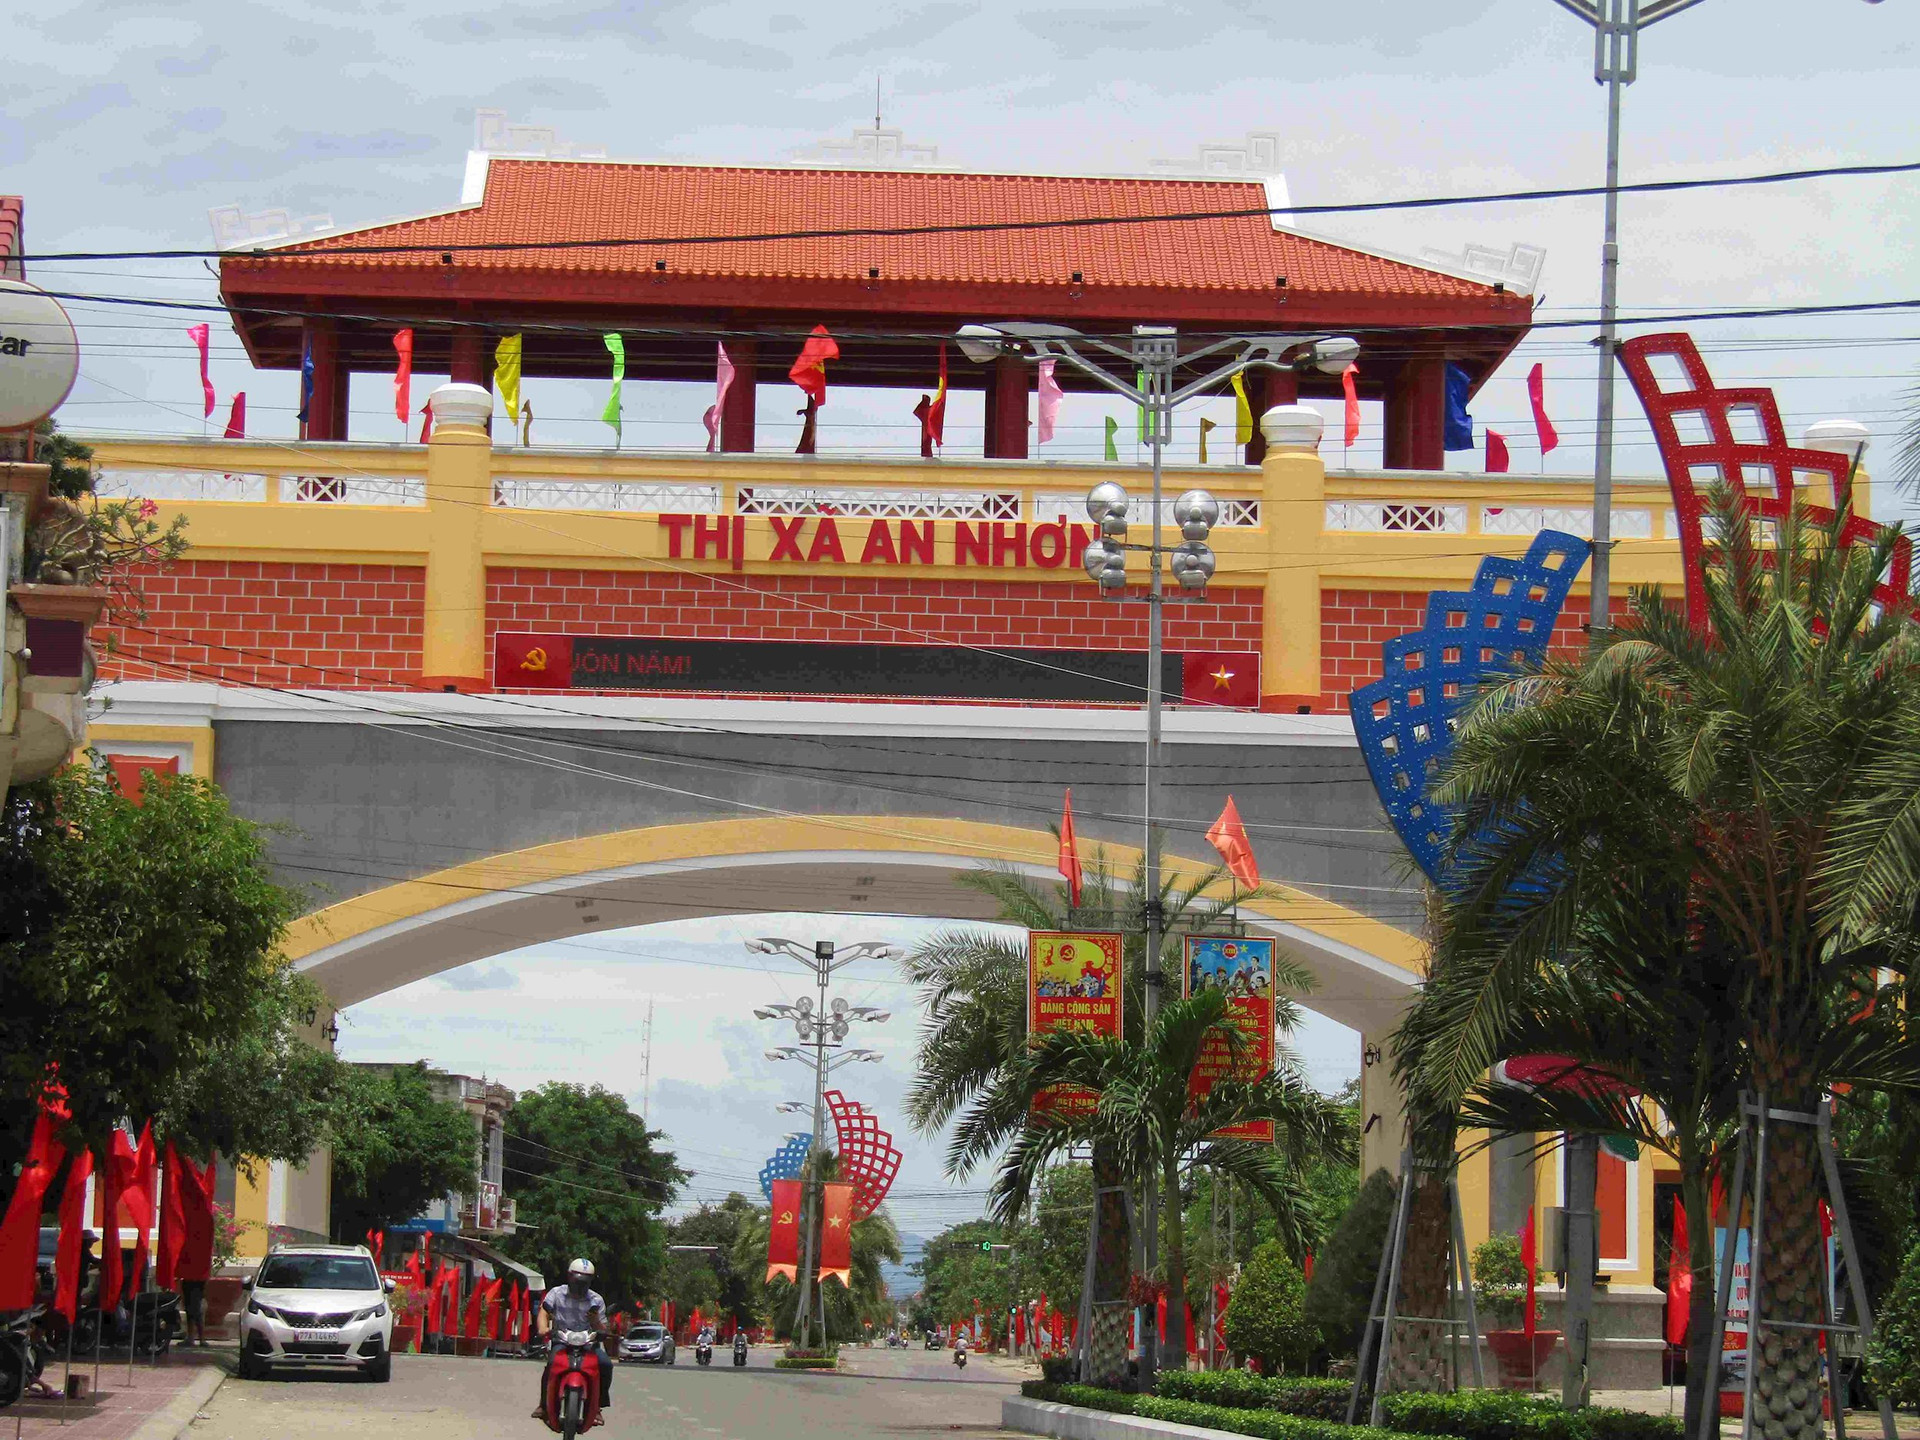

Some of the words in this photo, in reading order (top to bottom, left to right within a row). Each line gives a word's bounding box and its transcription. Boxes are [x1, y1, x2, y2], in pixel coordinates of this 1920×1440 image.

[0, 331, 32, 357] ar
[658, 514, 745, 571] THỊ
[769, 504, 846, 563] XÃ
[860, 519, 935, 564] AN
[955, 514, 1102, 569] NHƠN
[1040, 999, 1065, 1014] ĐẢNG
[1067, 1000, 1091, 1016] CỘNG
[1093, 1000, 1111, 1015] SẢN
